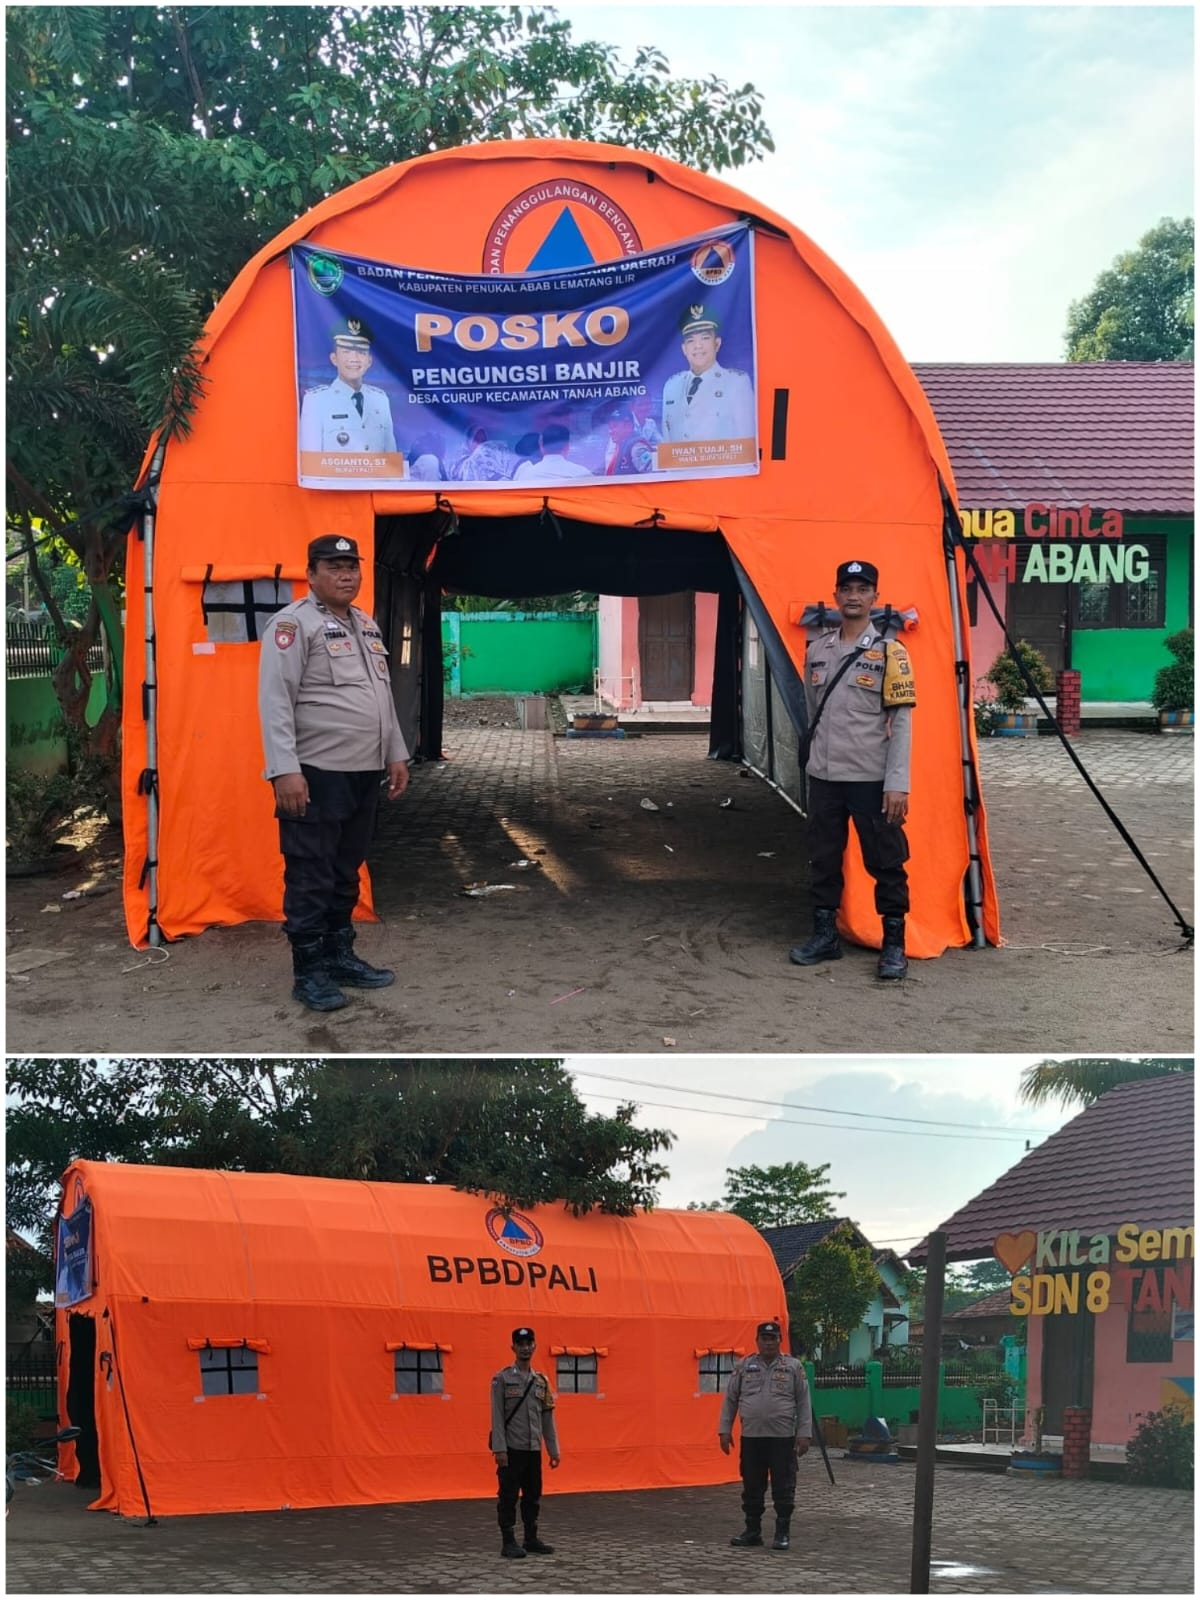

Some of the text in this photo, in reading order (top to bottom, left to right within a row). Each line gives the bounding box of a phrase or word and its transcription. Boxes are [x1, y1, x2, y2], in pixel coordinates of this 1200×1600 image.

[493, 185, 599, 246] PENANGGULANGAN
[357, 266, 404, 279] BADAN
[398, 273, 635, 294] KABUPATEN PENUKAL ABAB LEMATANG ILIR
[415, 306, 630, 352] POSKO
[411, 360, 640, 386] PENGUNGSI BANJIR
[408, 385, 646, 404] DESA CURUP KECAMATAN TANAH ABANG
[672, 447, 696, 456] IWAN
[1024, 502, 1123, 538] Cinta
[1022, 543, 1150, 583] ABANG
[856, 661, 884, 672] POLRI
[1036, 1223, 1194, 1268] Kita Sem
[427, 1255, 598, 1292] BPBDPALI
[1009, 1265, 1193, 1315] SDN 8 TAN
